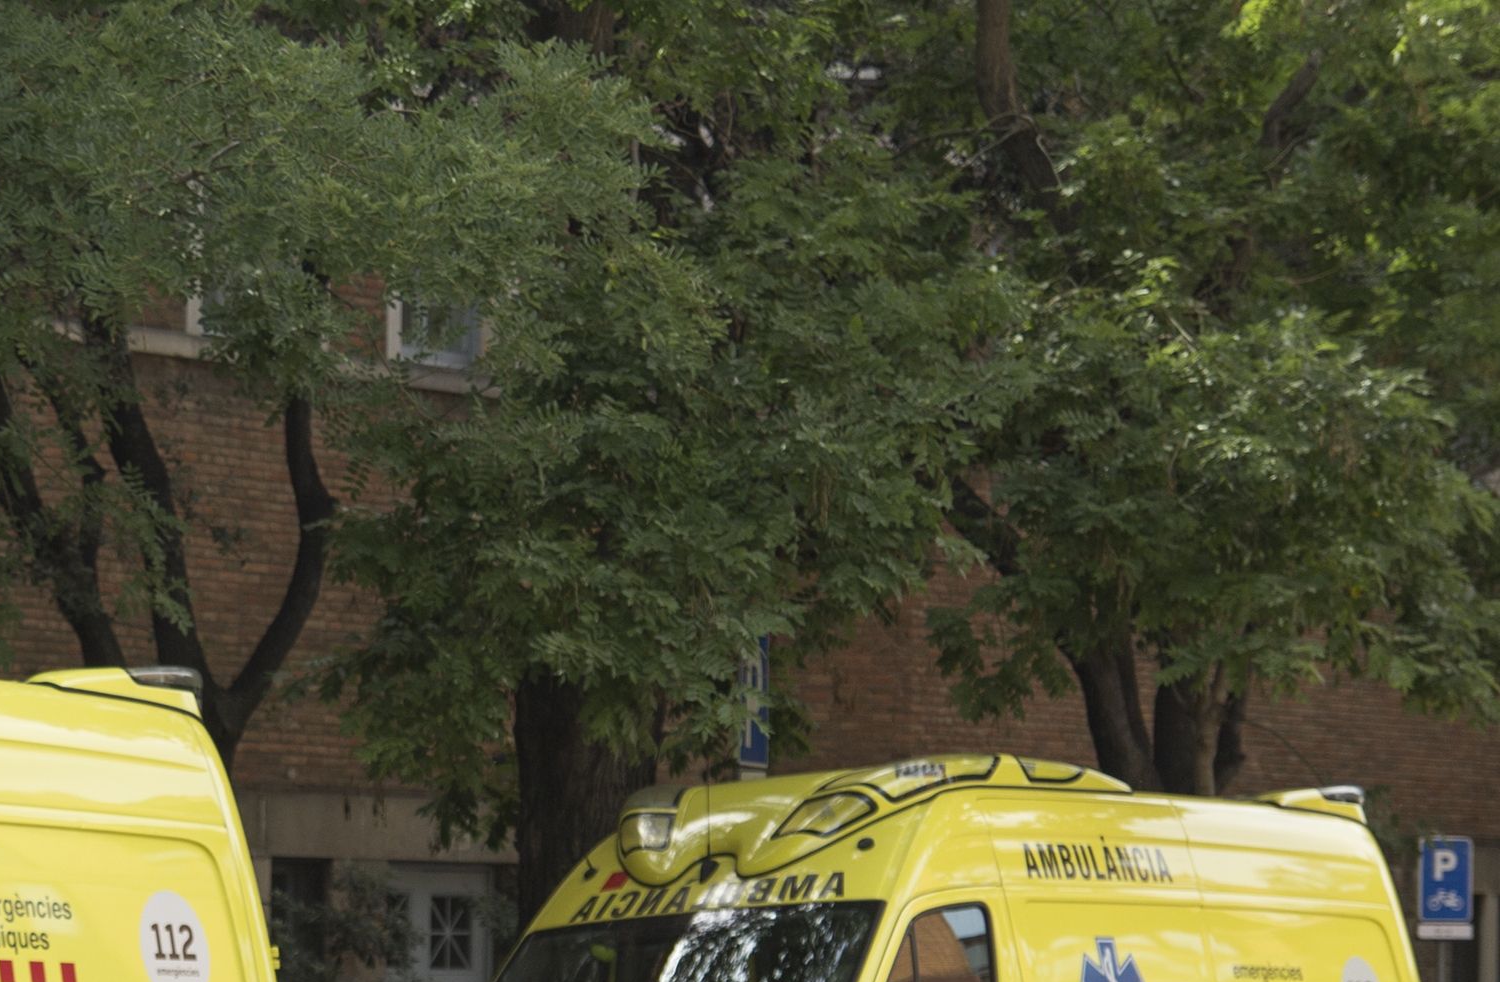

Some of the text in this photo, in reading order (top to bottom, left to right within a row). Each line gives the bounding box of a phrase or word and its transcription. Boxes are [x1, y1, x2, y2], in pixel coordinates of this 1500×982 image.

[1024, 836, 1173, 882] AMBULÀNCIA
[1433, 849, 1457, 881] P
[151, 923, 197, 961] 112
